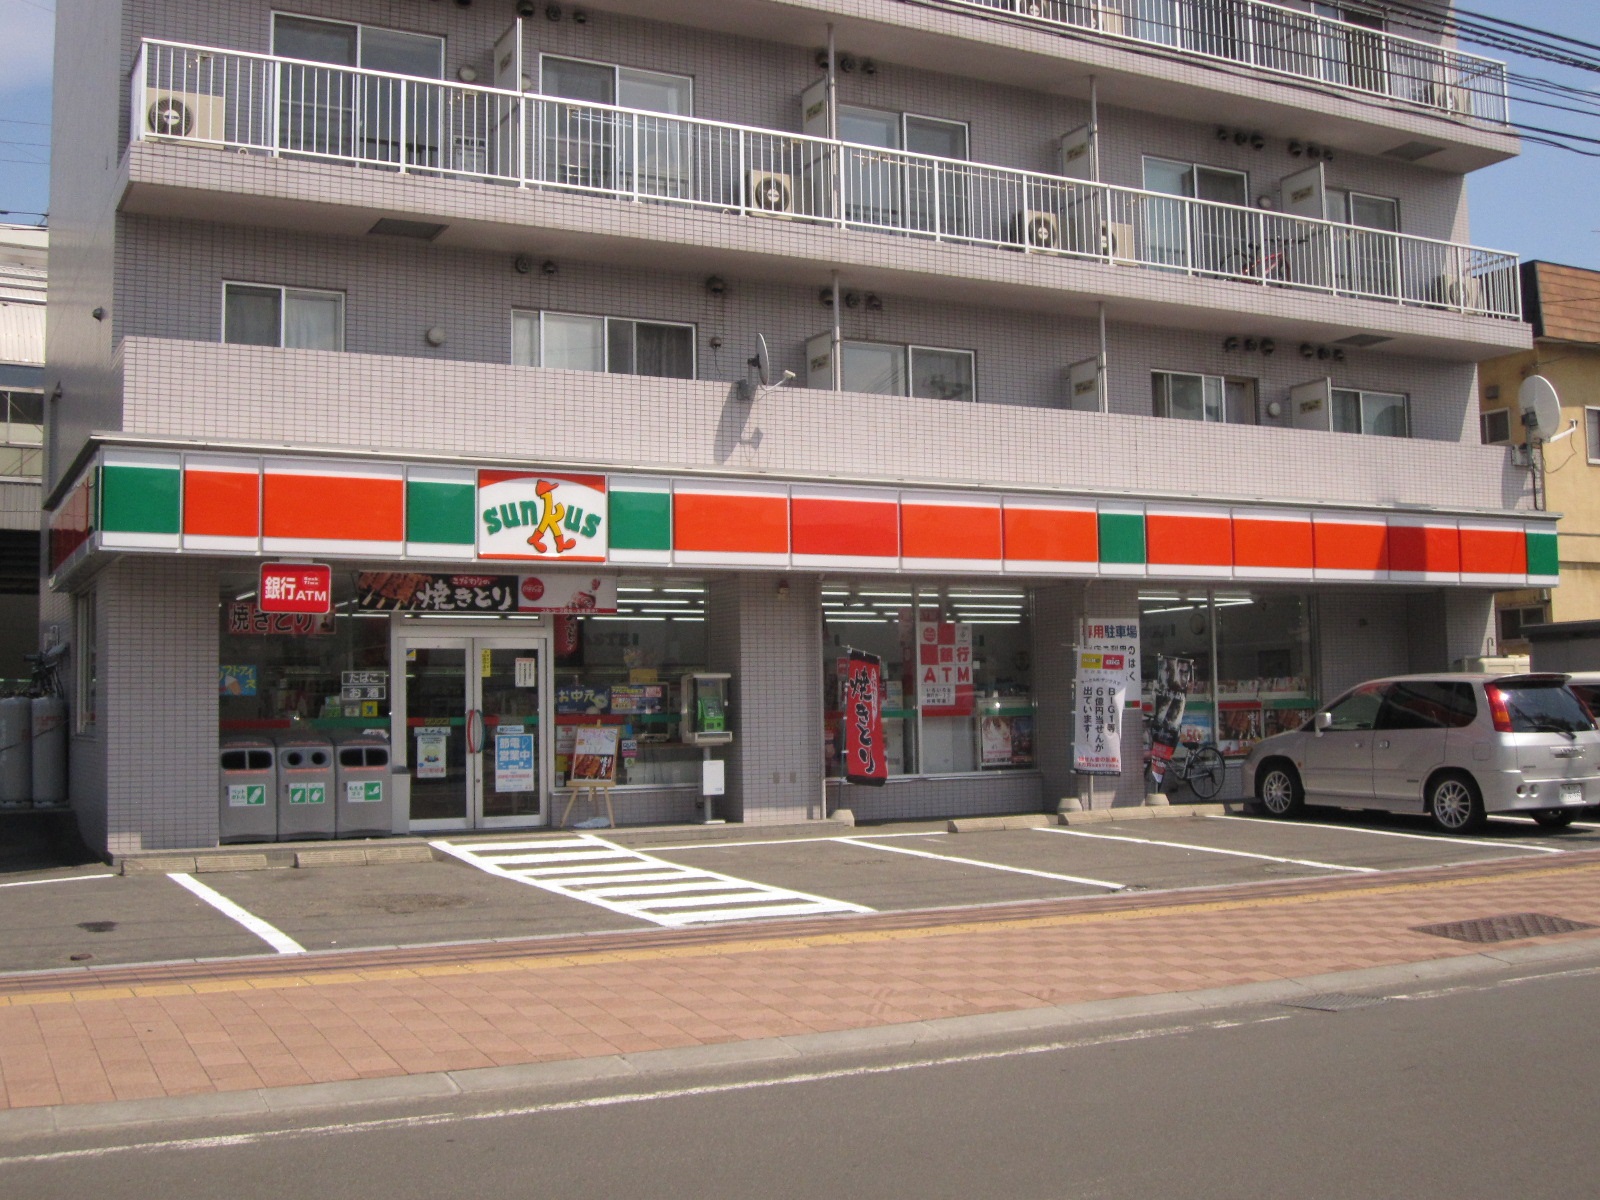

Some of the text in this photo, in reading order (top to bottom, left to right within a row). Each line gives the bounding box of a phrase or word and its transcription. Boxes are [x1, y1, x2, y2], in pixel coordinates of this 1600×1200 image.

[483, 479, 601, 553] sunkus
[265, 576, 327, 602] 銀行 ATM
[415, 579, 512, 610] 焼きとり
[231, 604, 313, 632] 焼きとり
[349, 674, 380, 684] たばこ
[924, 667, 970, 683] ATM
[349, 688, 379, 698] お酒
[558, 689, 596, 704] お中元
[849, 665, 876, 775] 焼きとり
[499, 749, 531, 761] 営業中
